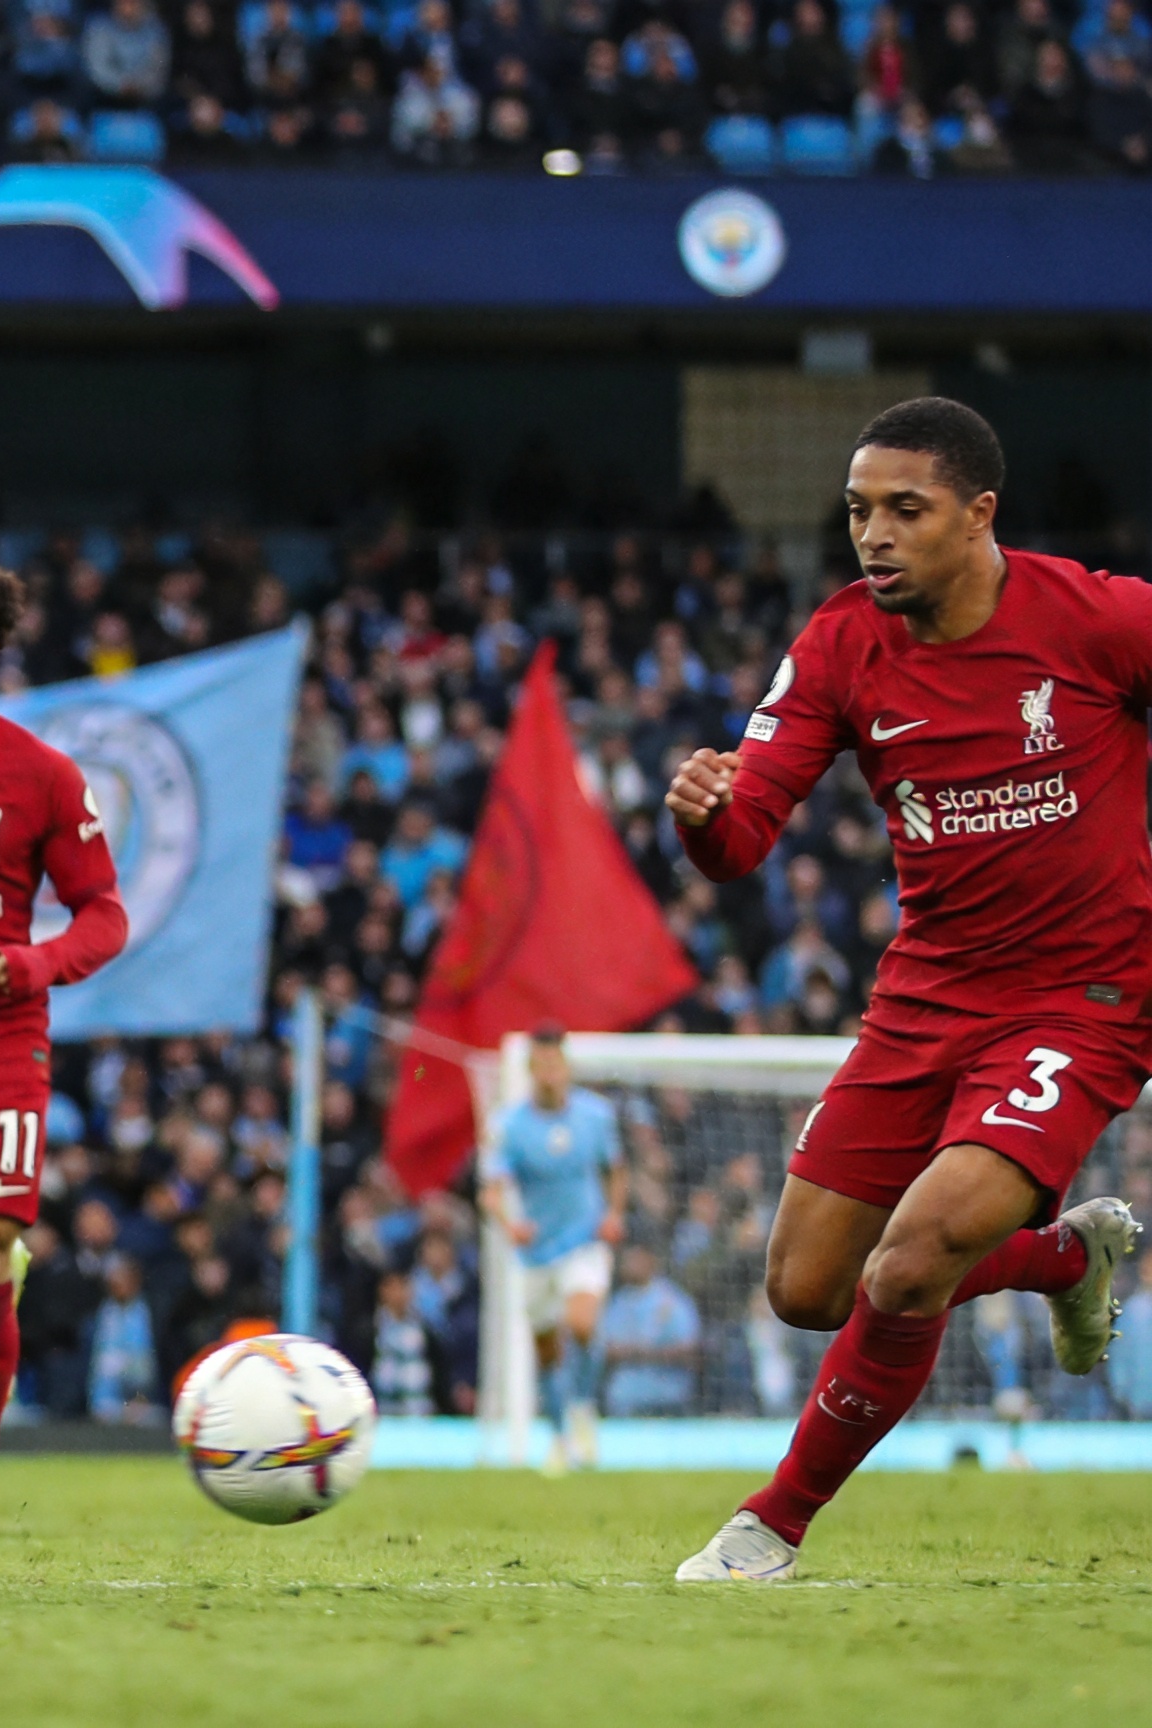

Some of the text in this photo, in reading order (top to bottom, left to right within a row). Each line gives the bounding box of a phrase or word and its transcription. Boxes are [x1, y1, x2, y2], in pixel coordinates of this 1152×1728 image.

[935, 770, 1065, 810] standard
[941, 790, 1079, 834] chartered
[1007, 1046, 1074, 1113] 3
